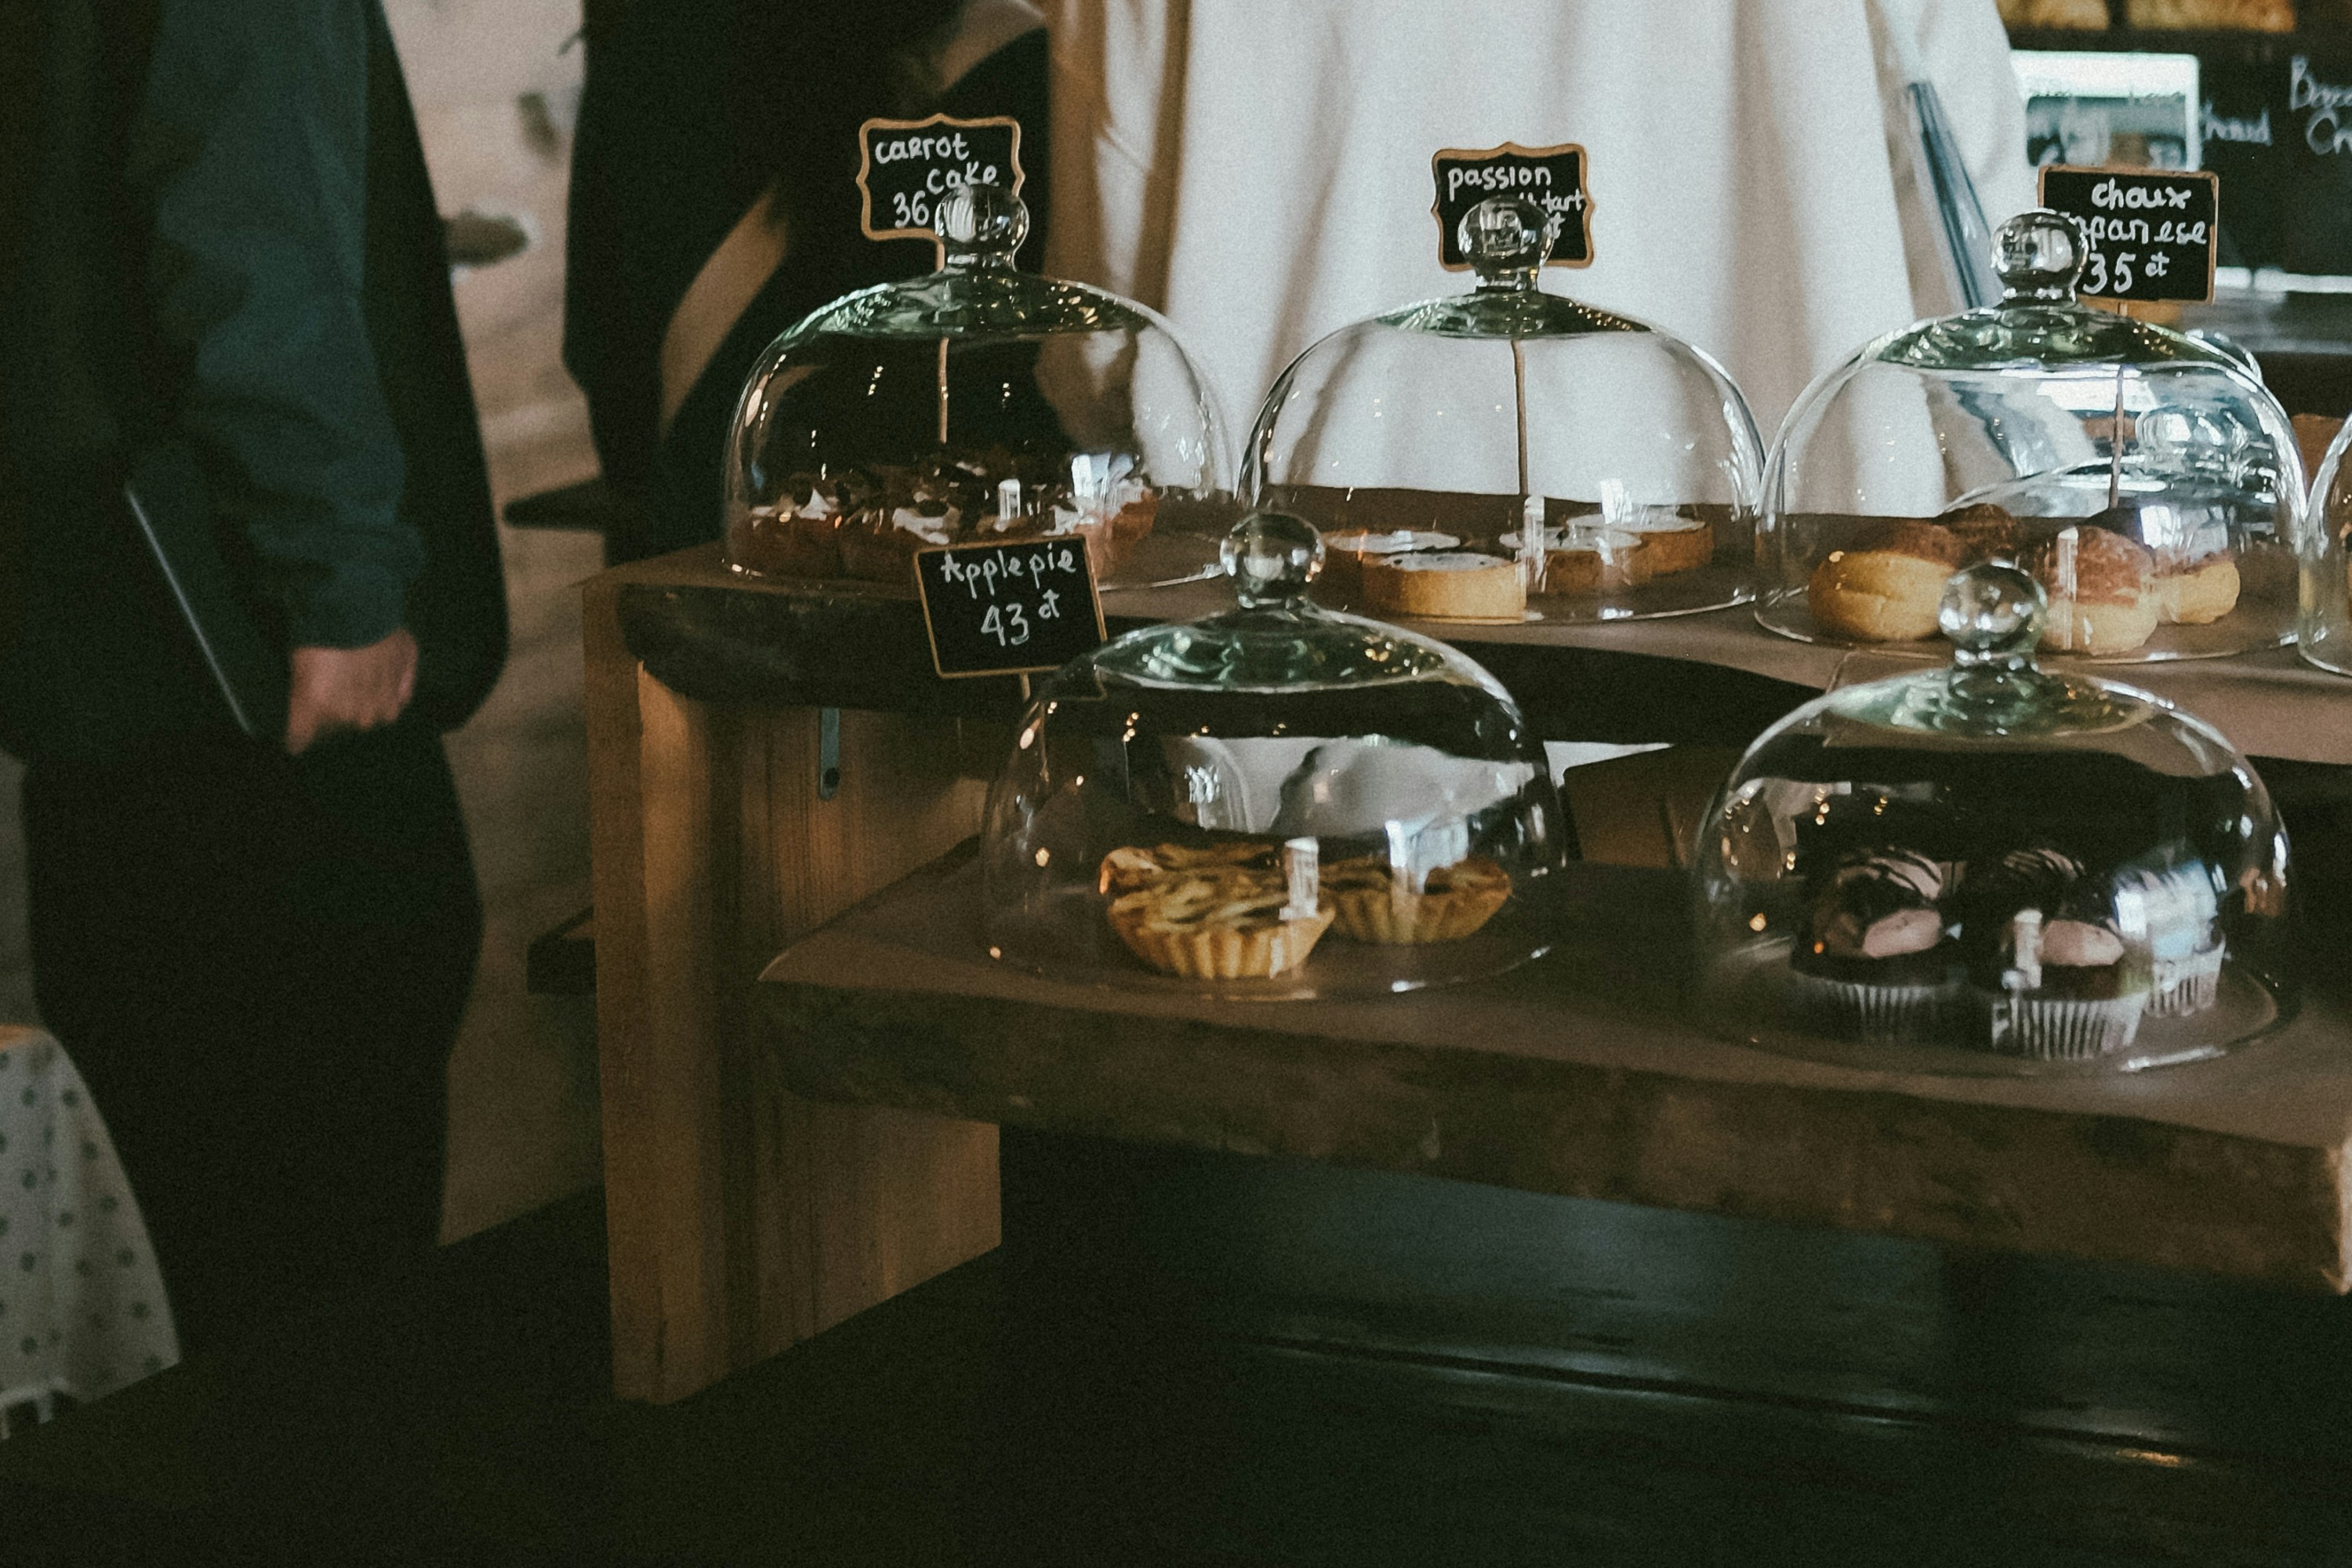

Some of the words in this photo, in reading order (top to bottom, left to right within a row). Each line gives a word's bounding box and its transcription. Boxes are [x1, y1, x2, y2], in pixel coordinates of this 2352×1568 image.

[875, 132, 970, 165] carrot
[1447, 165, 1552, 202] passion
[1541, 187, 1585, 214] tart
[2082, 252, 2137, 295] 35
[980, 602, 1030, 647] 43
